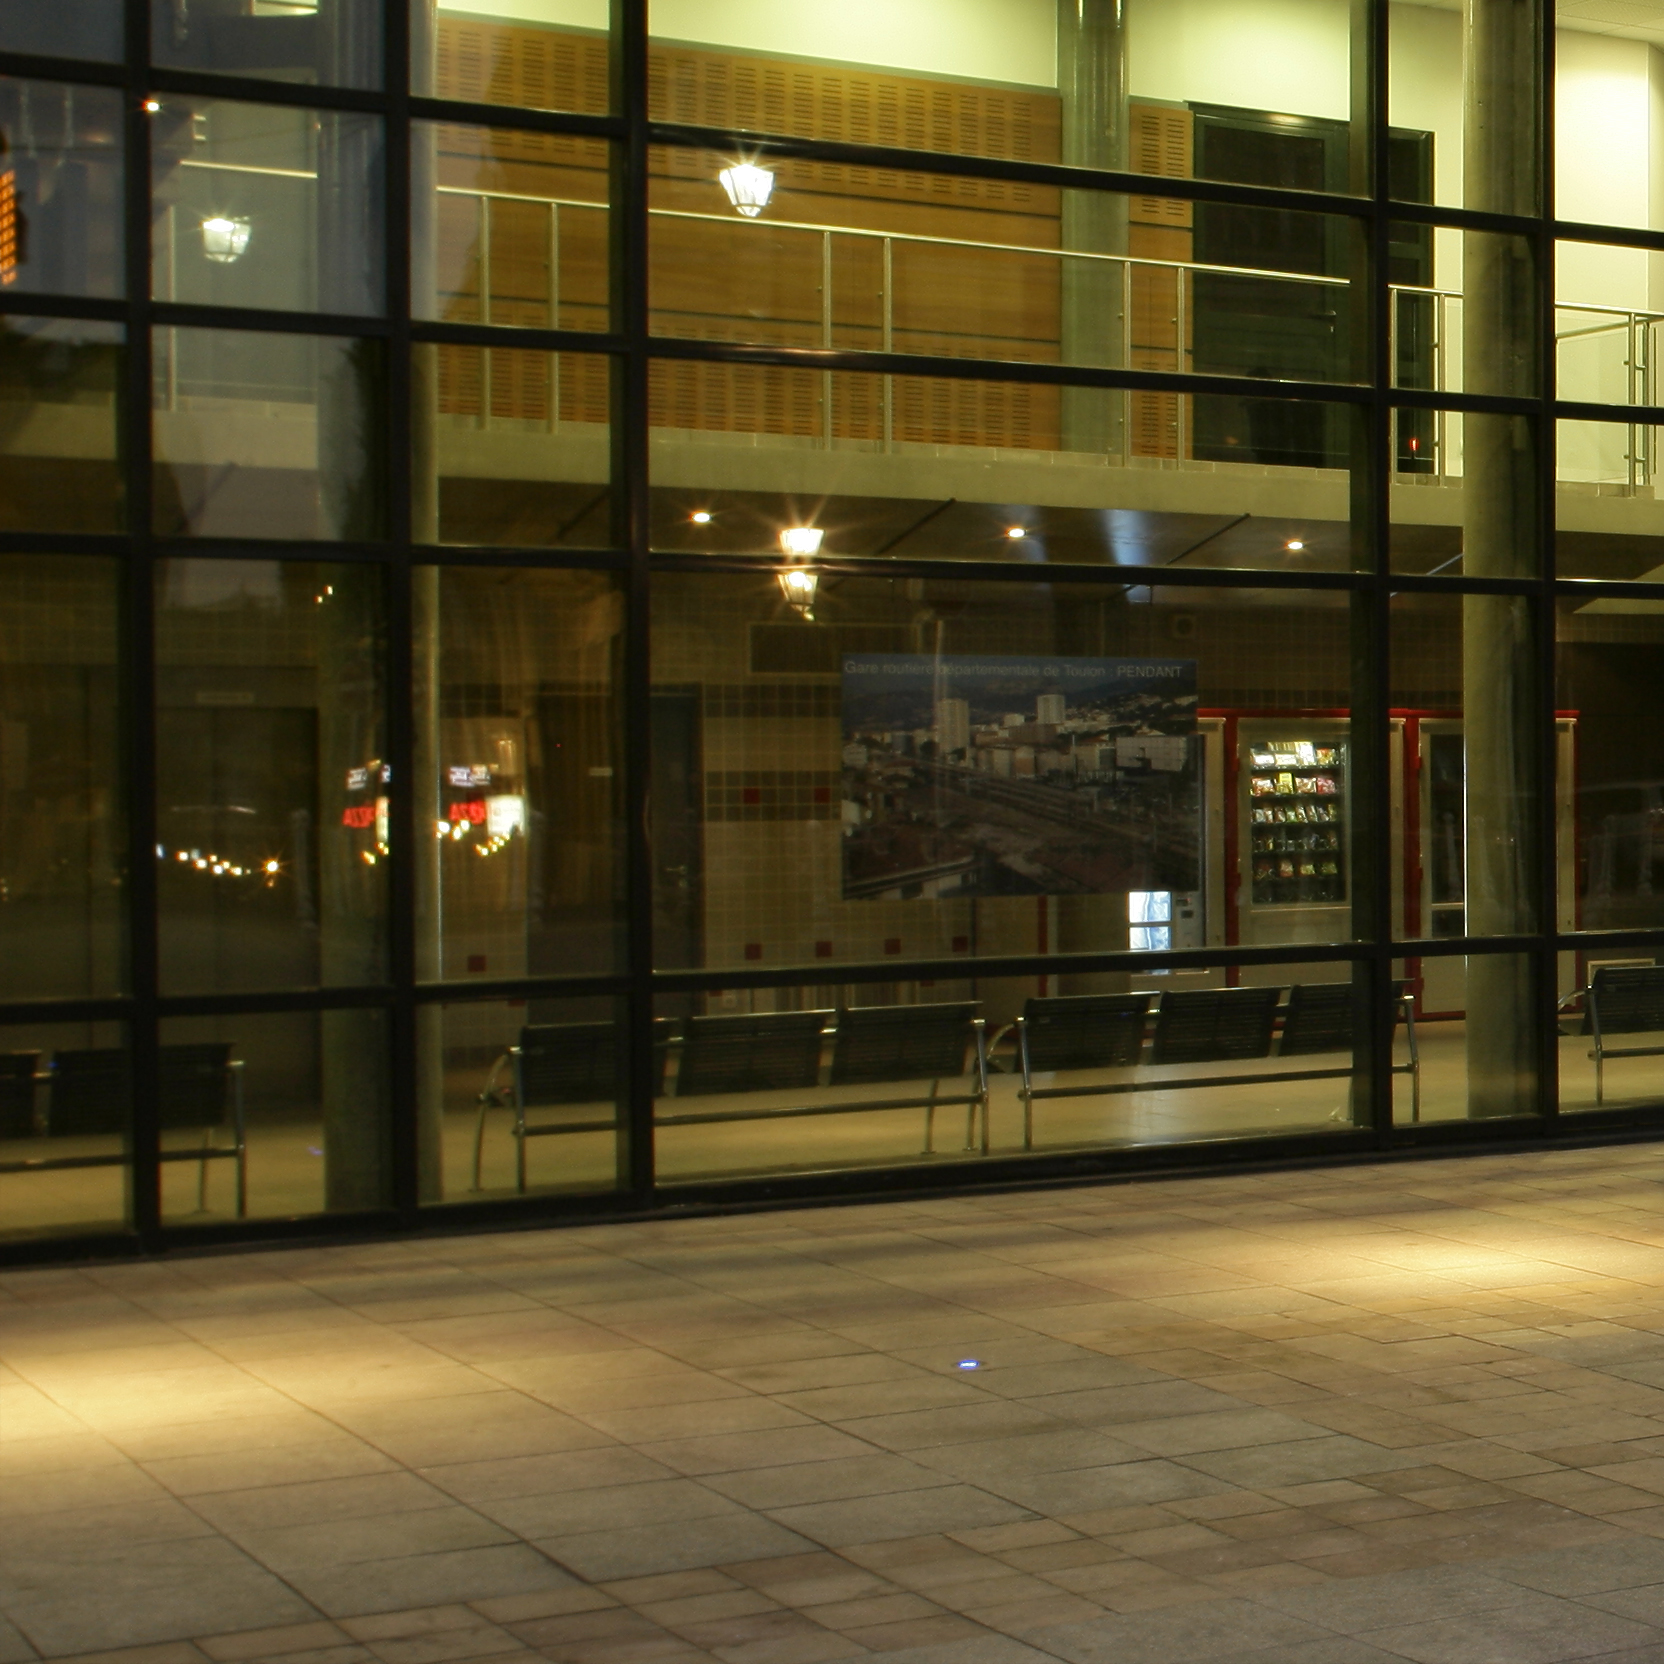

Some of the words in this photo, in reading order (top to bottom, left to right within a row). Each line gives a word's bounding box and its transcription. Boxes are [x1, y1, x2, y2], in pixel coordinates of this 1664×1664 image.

[844, 660, 879, 675] Gare
[1043, 664, 1060, 677] de
[1064, 664, 1105, 678] Toulon
[1117, 665, 1183, 679] PENDANT
